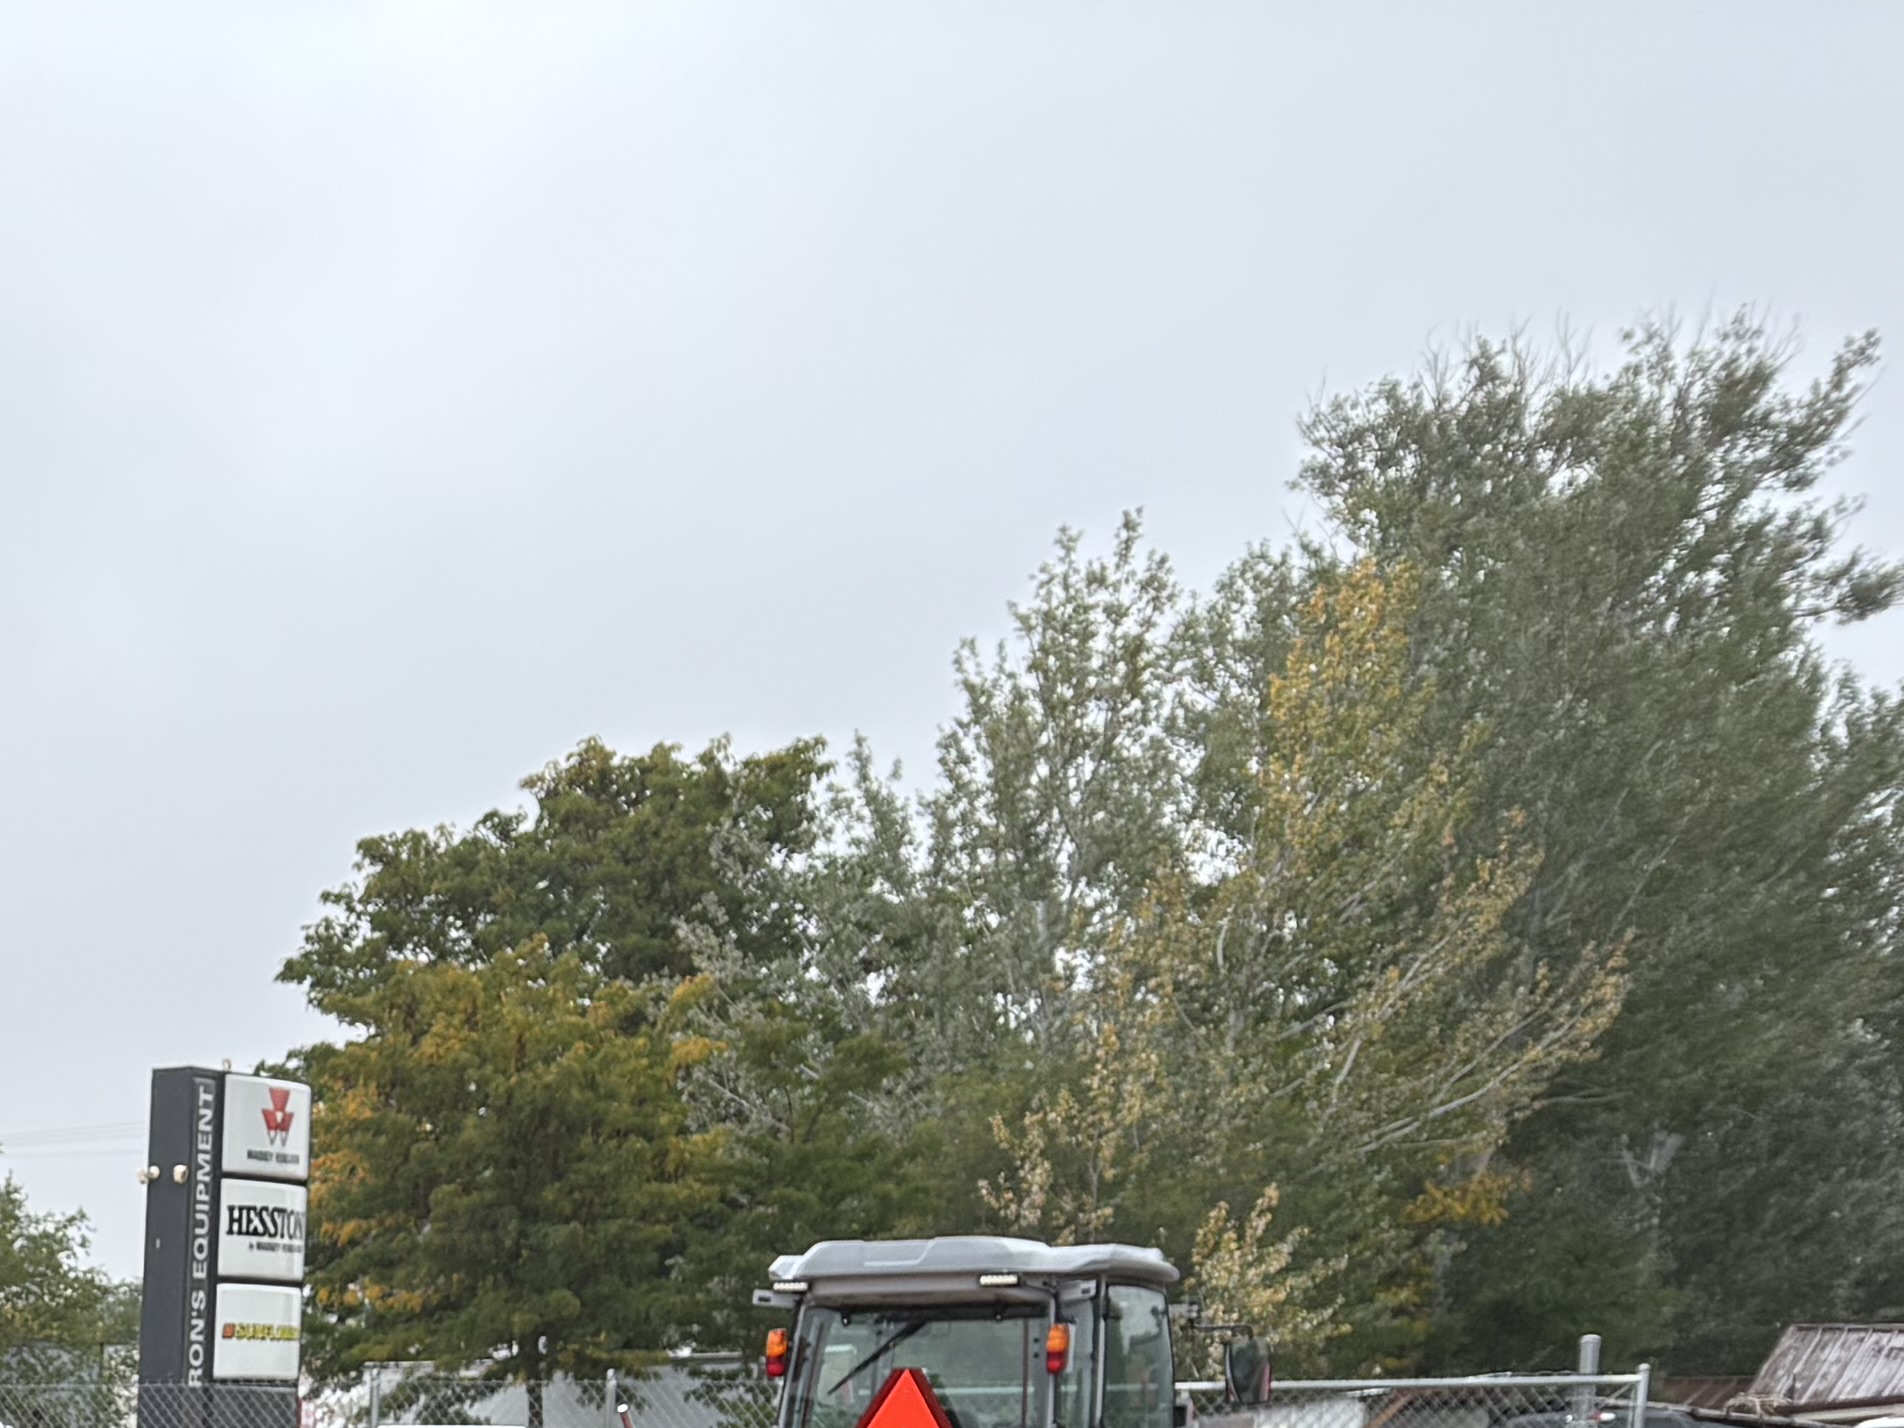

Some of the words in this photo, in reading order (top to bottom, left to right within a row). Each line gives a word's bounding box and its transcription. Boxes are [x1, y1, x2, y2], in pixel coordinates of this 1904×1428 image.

[191, 1085, 216, 1280] EQUIPMENT
[226, 1204, 306, 1239] HESSTON
[187, 1290, 206, 1387] RON'S
